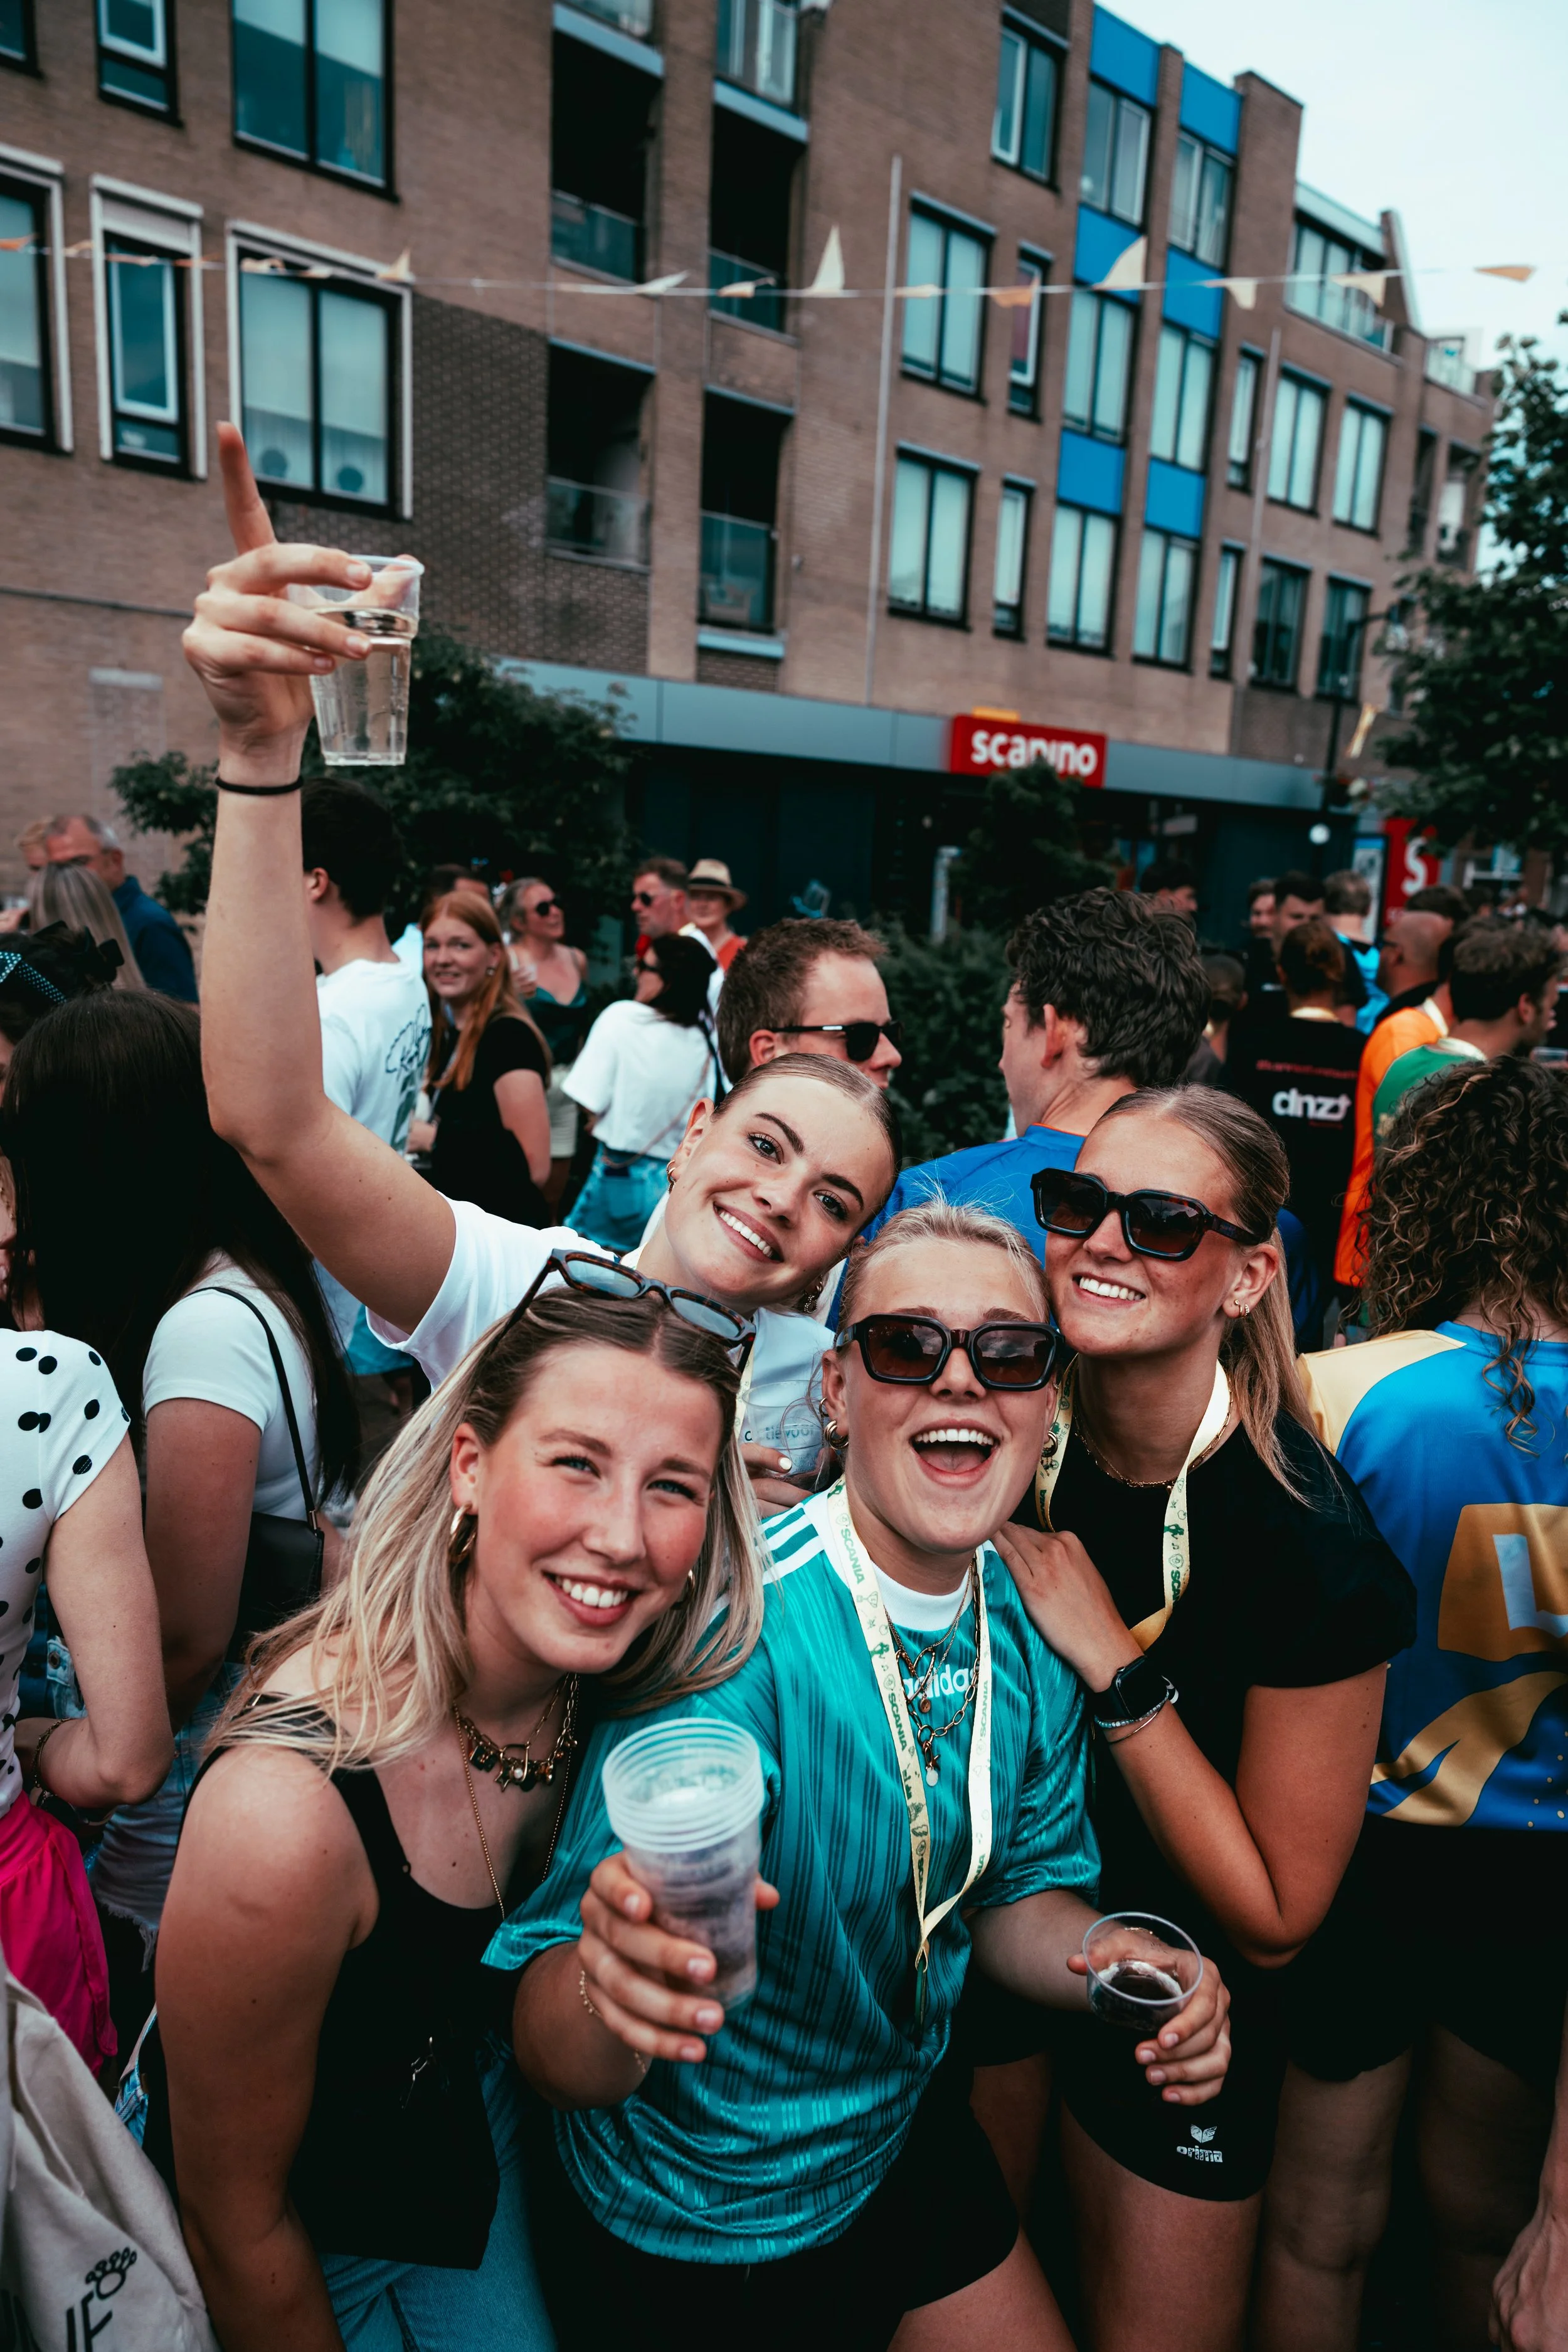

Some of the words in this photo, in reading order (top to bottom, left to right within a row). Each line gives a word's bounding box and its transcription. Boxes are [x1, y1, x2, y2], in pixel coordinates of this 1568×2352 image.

[840, 1528, 864, 1585] SCANIA
[888, 1692, 907, 1752] SCANIA
[980, 1680, 989, 1738] SCANIA
